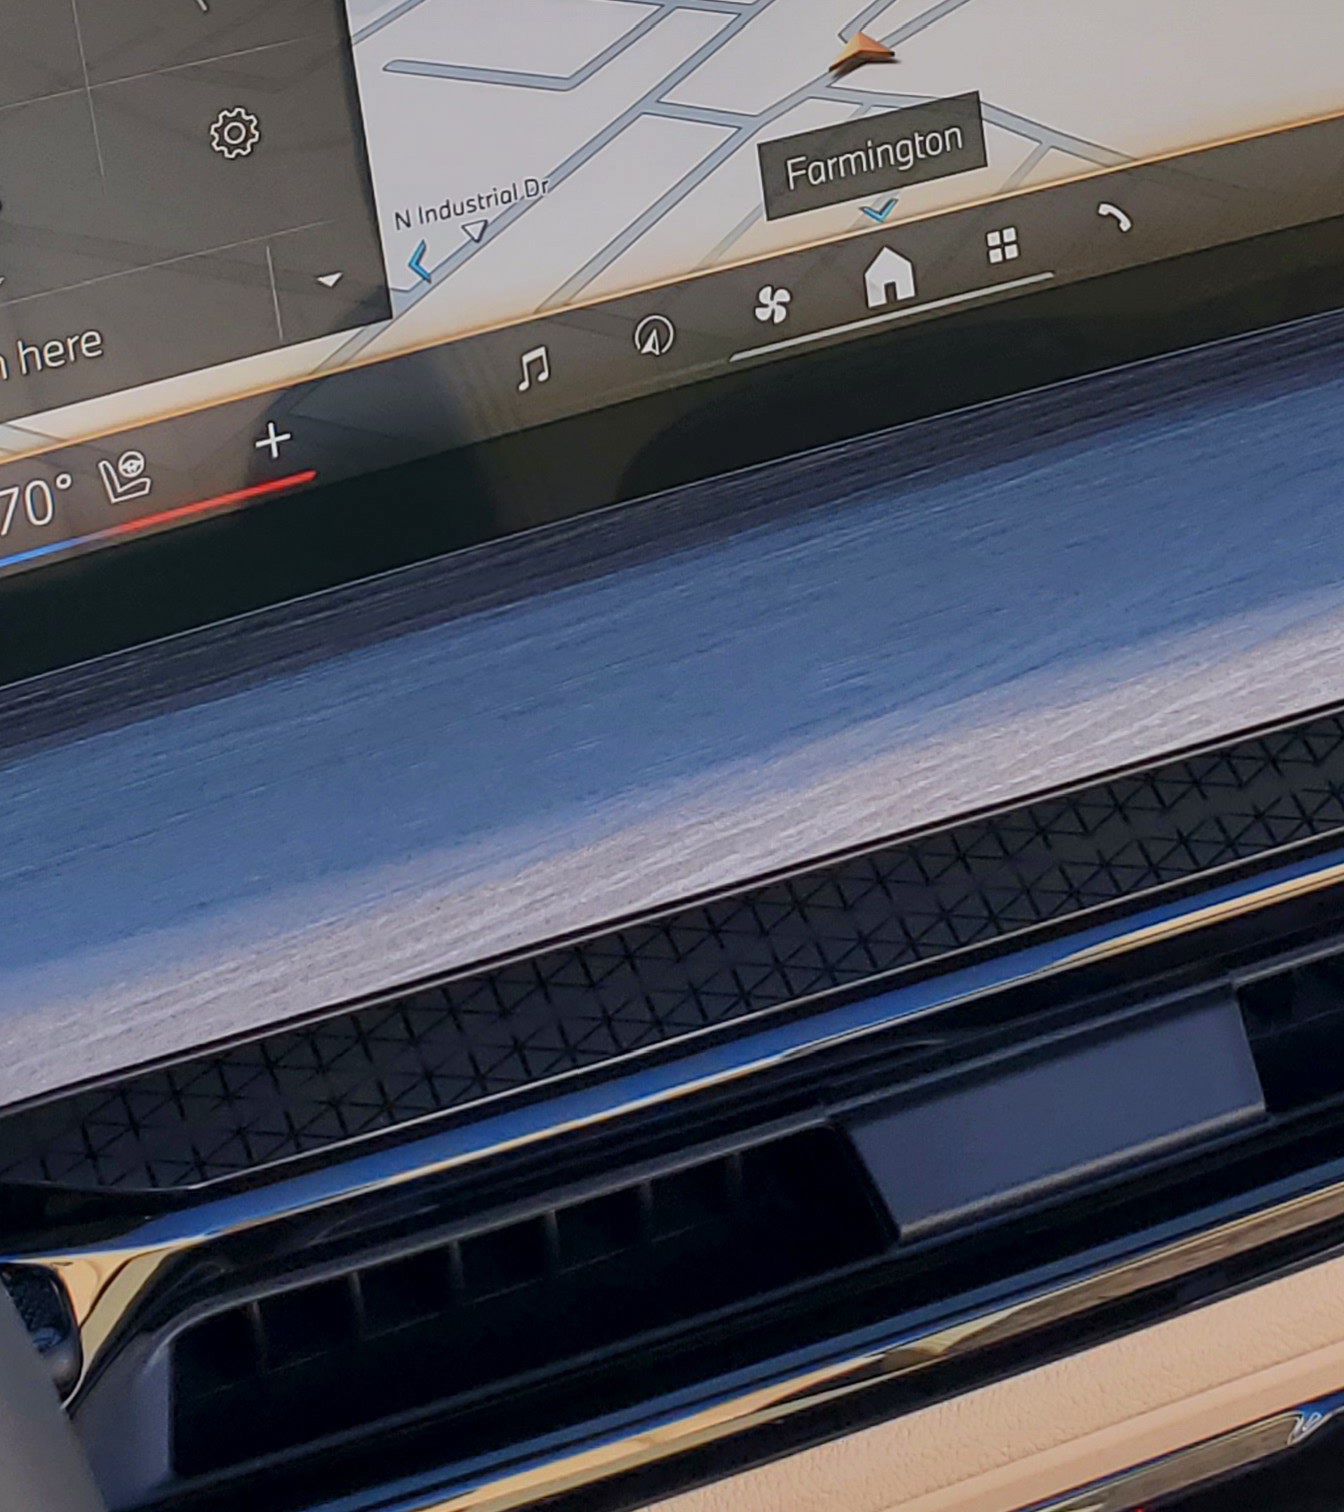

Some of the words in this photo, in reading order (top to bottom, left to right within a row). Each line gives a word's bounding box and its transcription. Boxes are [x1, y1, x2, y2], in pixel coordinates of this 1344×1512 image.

[784, 123, 964, 192] Farmington
[395, 208, 415, 231] N
[418, 184, 523, 227] Industrial
[525, 176, 550, 199] Dr
[16, 326, 103, 380] here
